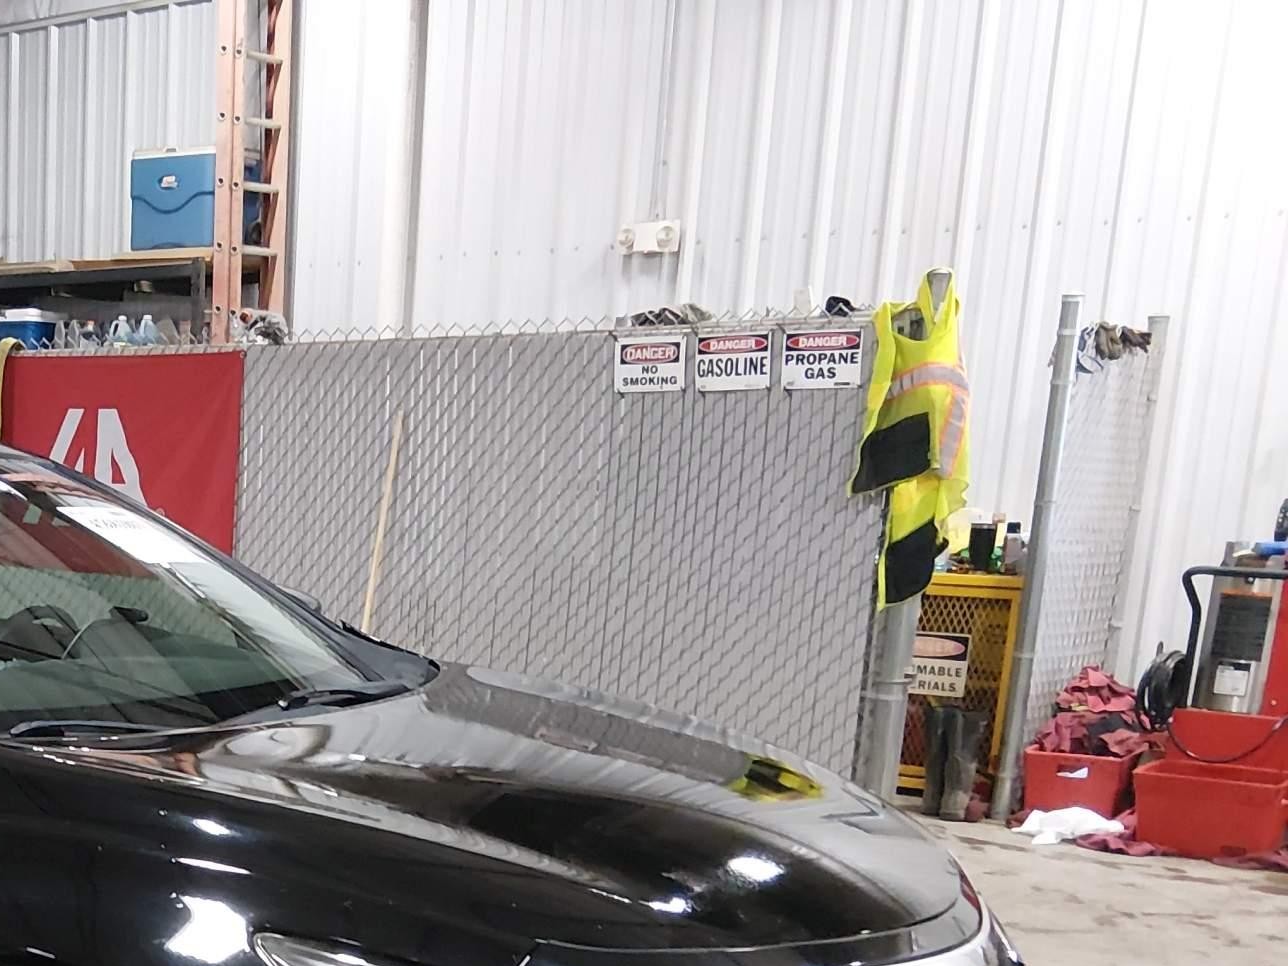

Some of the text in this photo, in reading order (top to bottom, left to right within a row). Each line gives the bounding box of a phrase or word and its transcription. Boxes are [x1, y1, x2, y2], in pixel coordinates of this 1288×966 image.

[709, 339, 756, 351] DANGER
[798, 335, 848, 349] DANGER
[626, 346, 674, 360] DANGER
[785, 352, 859, 366] PROPANE
[641, 365, 658, 374] NO
[697, 356, 768, 378] GASOLINE
[804, 366, 836, 380] GAS
[622, 376, 678, 387] SMOKING
[913, 664, 963, 678] MABLE
[912, 680, 957, 692] RIALS
